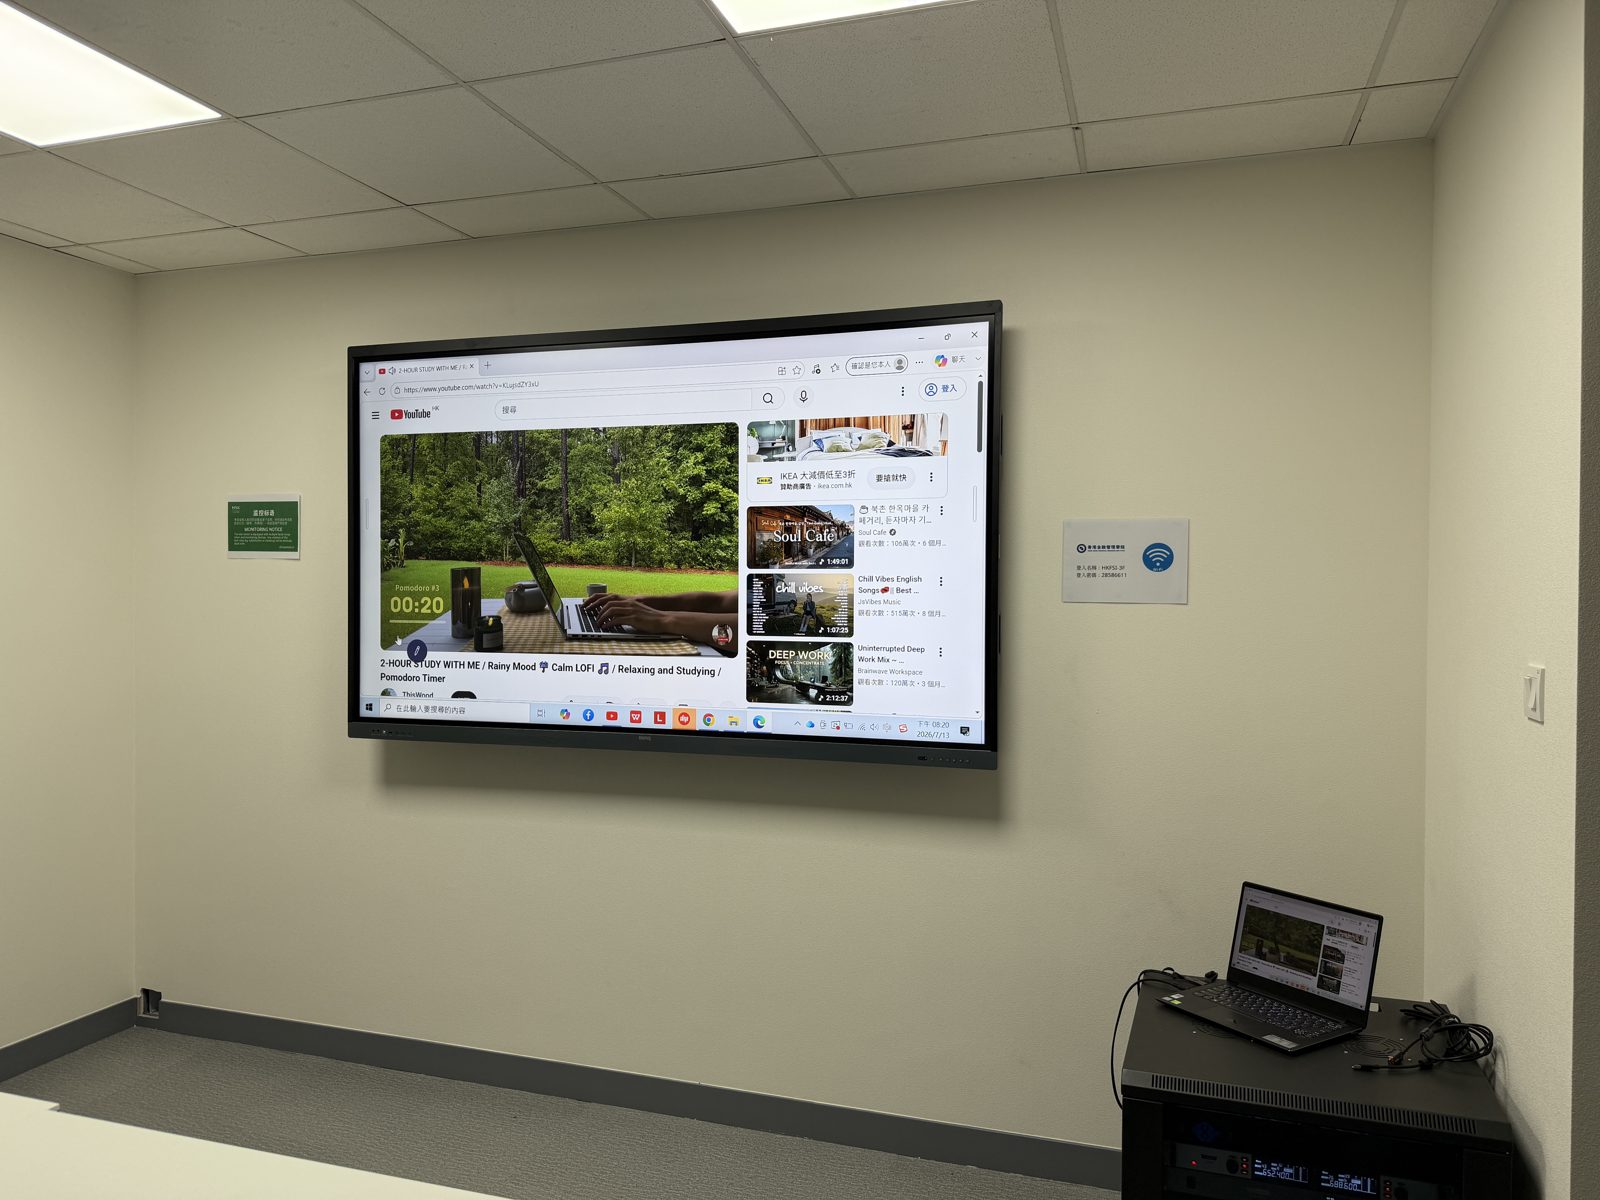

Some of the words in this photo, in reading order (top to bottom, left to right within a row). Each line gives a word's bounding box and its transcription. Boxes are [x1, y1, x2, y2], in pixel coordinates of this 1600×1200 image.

[852, 361, 891, 370] 確認是您本人
[942, 384, 957, 393] 登入
[403, 409, 431, 419] YouTube
[502, 406, 517, 414] 搜尋
[800, 470, 856, 480] 大減價低至3折
[773, 530, 801, 542] Soul
[896, 575, 922, 585] English
[775, 581, 795, 594] chill
[798, 582, 824, 593] vibes
[858, 587, 880, 596] Songs
[390, 597, 444, 614] 00:20
[858, 645, 906, 653] Uninterrupted
[907, 646, 925, 654] Deep
[769, 650, 795, 659] DEEP
[798, 651, 830, 660] WORK
[380, 659, 412, 668] 2-HOUR
[413, 660, 441, 669] STUDY
[444, 661, 465, 670] WITH
[468, 662, 480, 670] ME
[488, 662, 510, 672] Rainy
[512, 662, 536, 671] Mood
[551, 663, 573, 672] Calm
[575, 664, 595, 673] LOFI
[618, 665, 655, 676] Relaxing
[657, 666, 674, 675] and
[676, 666, 716, 677] Studying
[380, 673, 420, 682] Pomodoro
[422, 674, 446, 682] Timer
[397, 705, 466, 714] 在此輸入要搜尋的內容
